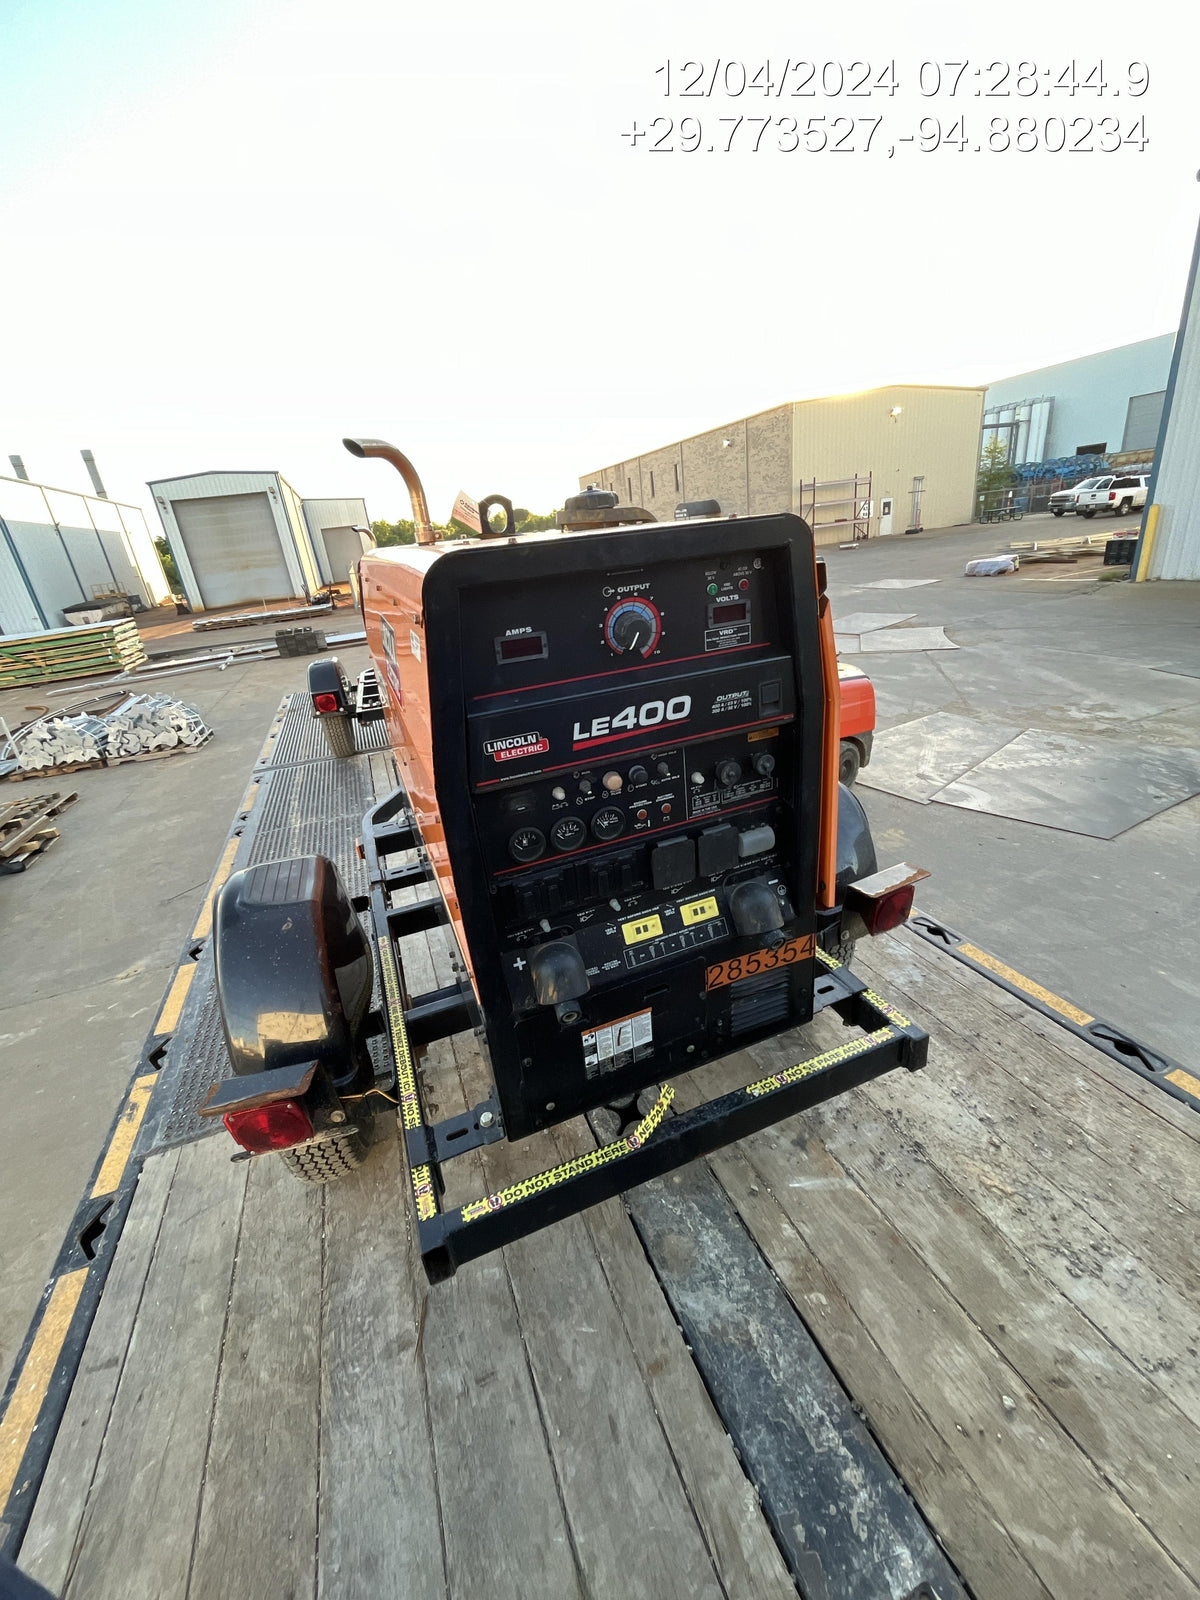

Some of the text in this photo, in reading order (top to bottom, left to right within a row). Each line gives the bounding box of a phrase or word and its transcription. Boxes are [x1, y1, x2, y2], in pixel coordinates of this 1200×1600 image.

[618, 582, 650, 593] OUTPUT
[716, 594, 739, 603] VOLTS
[506, 626, 532, 636] AMPS
[573, 695, 692, 741] LE400
[486, 734, 537, 752] LINCOLN
[500, 744, 544, 758] ELECTRIC
[709, 934, 815, 989] 285354
[398, 1050, 409, 1080] DEBOUT
[760, 1040, 865, 1091] ICI NO SE PARE AQUI
[403, 1079, 411, 1091] ICI
[406, 1103, 415, 1116] NO
[408, 1118, 417, 1130] SE
[504, 1188, 524, 1202] DO
[525, 1176, 551, 1194] NOT
[554, 1158, 594, 1181] STAND
[596, 1143, 628, 1162] HERE
[639, 1122, 656, 1138] NE
[415, 1164, 427, 1184] QUI
